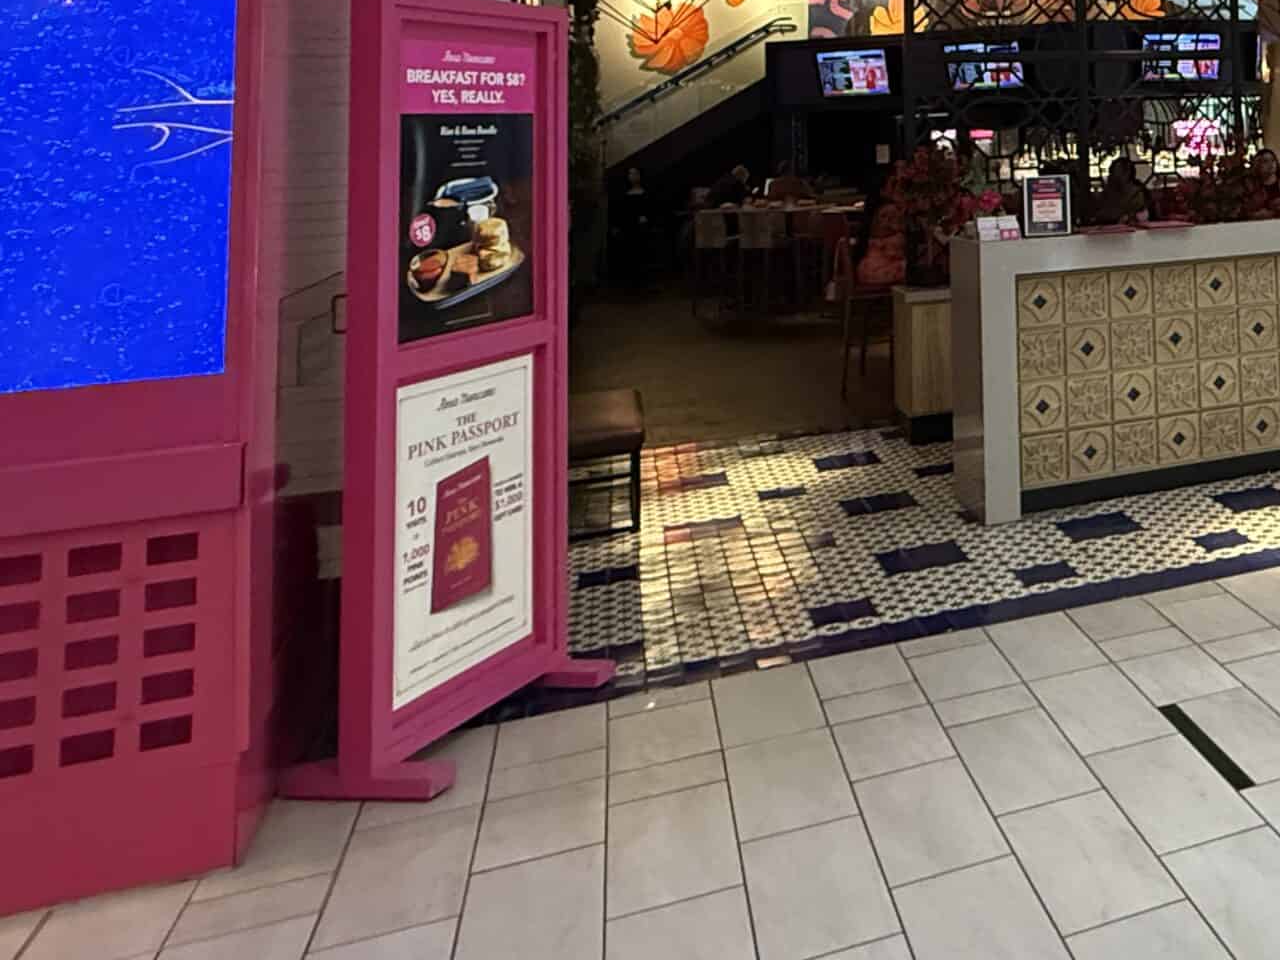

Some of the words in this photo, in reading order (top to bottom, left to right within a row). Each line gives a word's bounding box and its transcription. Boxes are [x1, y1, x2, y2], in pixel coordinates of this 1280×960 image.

[406, 68, 479, 85] BREAKFAST
[480, 71, 504, 86] FOR
[506, 72, 526, 87] $8?
[432, 88, 459, 105] YES,
[461, 90, 506, 104] REALLY.
[456, 412, 477, 426] THE
[408, 434, 447, 460] PINK
[451, 411, 520, 446] PASSPORT
[407, 496, 427, 517] 10
